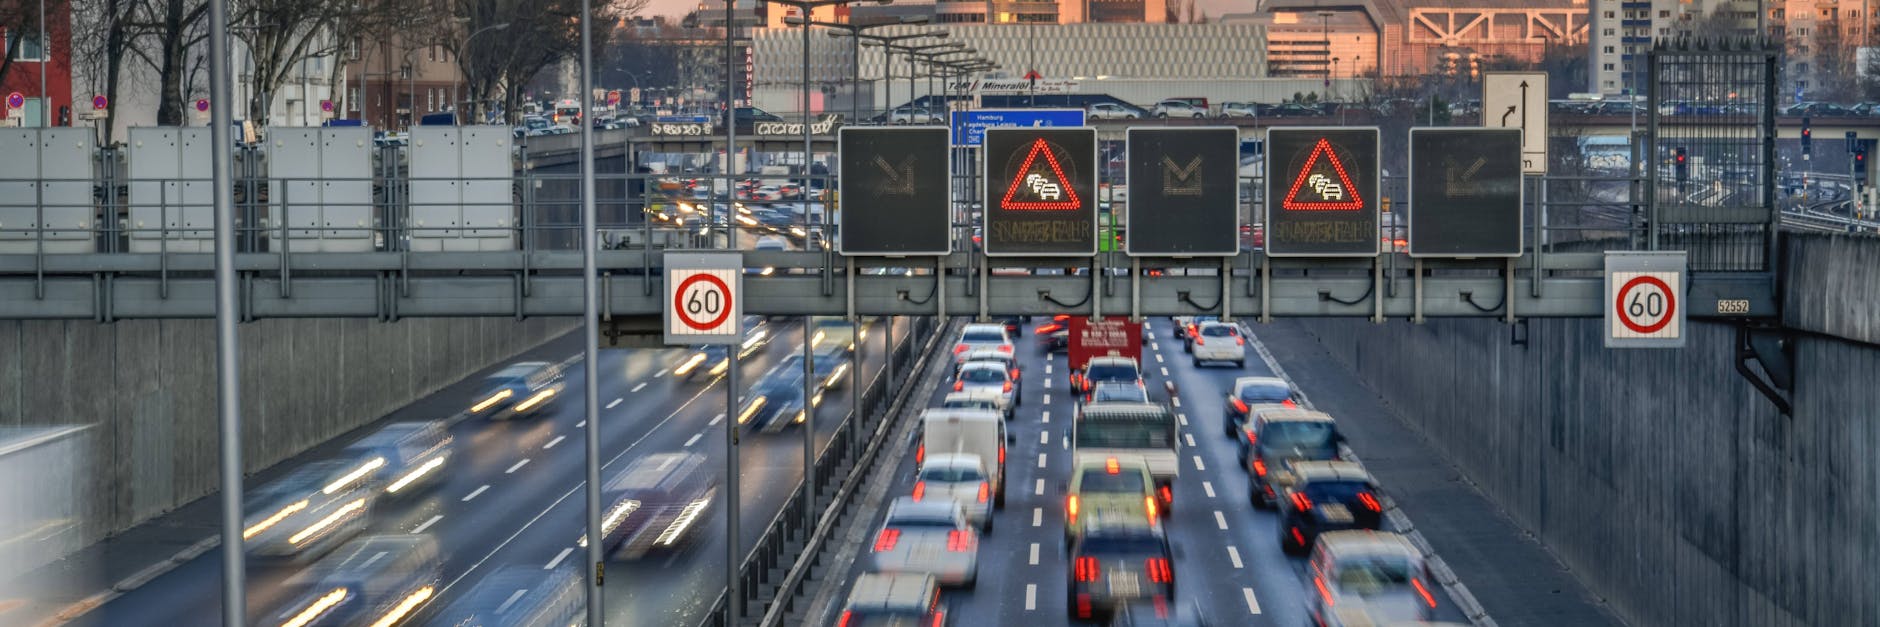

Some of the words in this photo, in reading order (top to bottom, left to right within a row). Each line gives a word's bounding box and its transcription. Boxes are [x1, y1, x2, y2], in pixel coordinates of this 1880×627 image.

[982, 80, 1029, 90] Mineralöl
[688, 289, 719, 314] 60
[1629, 292, 1662, 317] 60
[1719, 301, 1748, 312] 52552
